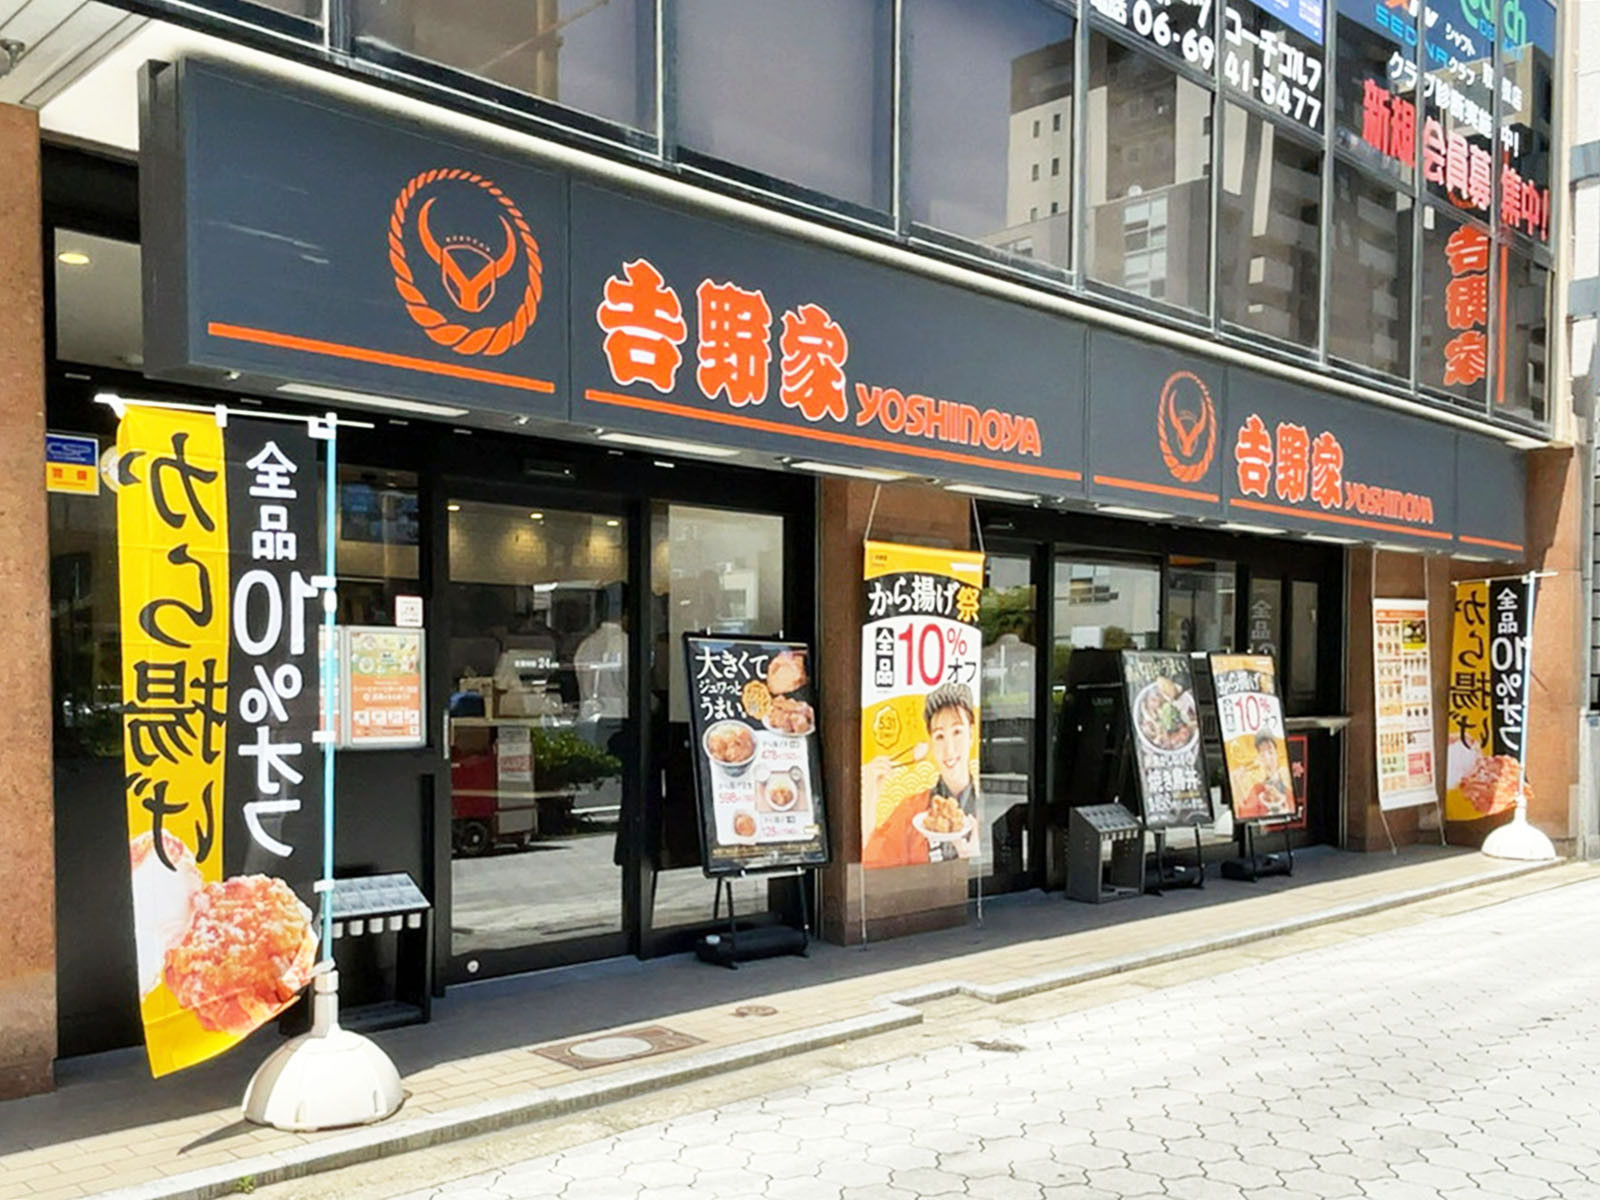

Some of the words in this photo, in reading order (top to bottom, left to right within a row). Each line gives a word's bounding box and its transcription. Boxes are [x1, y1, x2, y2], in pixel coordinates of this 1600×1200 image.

[1443, 222, 1490, 387] 吉野家
[597, 257, 850, 422] 吉野家
[855, 382, 1042, 457] YOSHINOYA
[1234, 413, 1344, 509] 吉野家
[1344, 481, 1434, 525] YOSHINOYA
[868, 574, 981, 622] から揚げ祭
[695, 646, 768, 679] 大きくて
[875, 627, 895, 687] 全品
